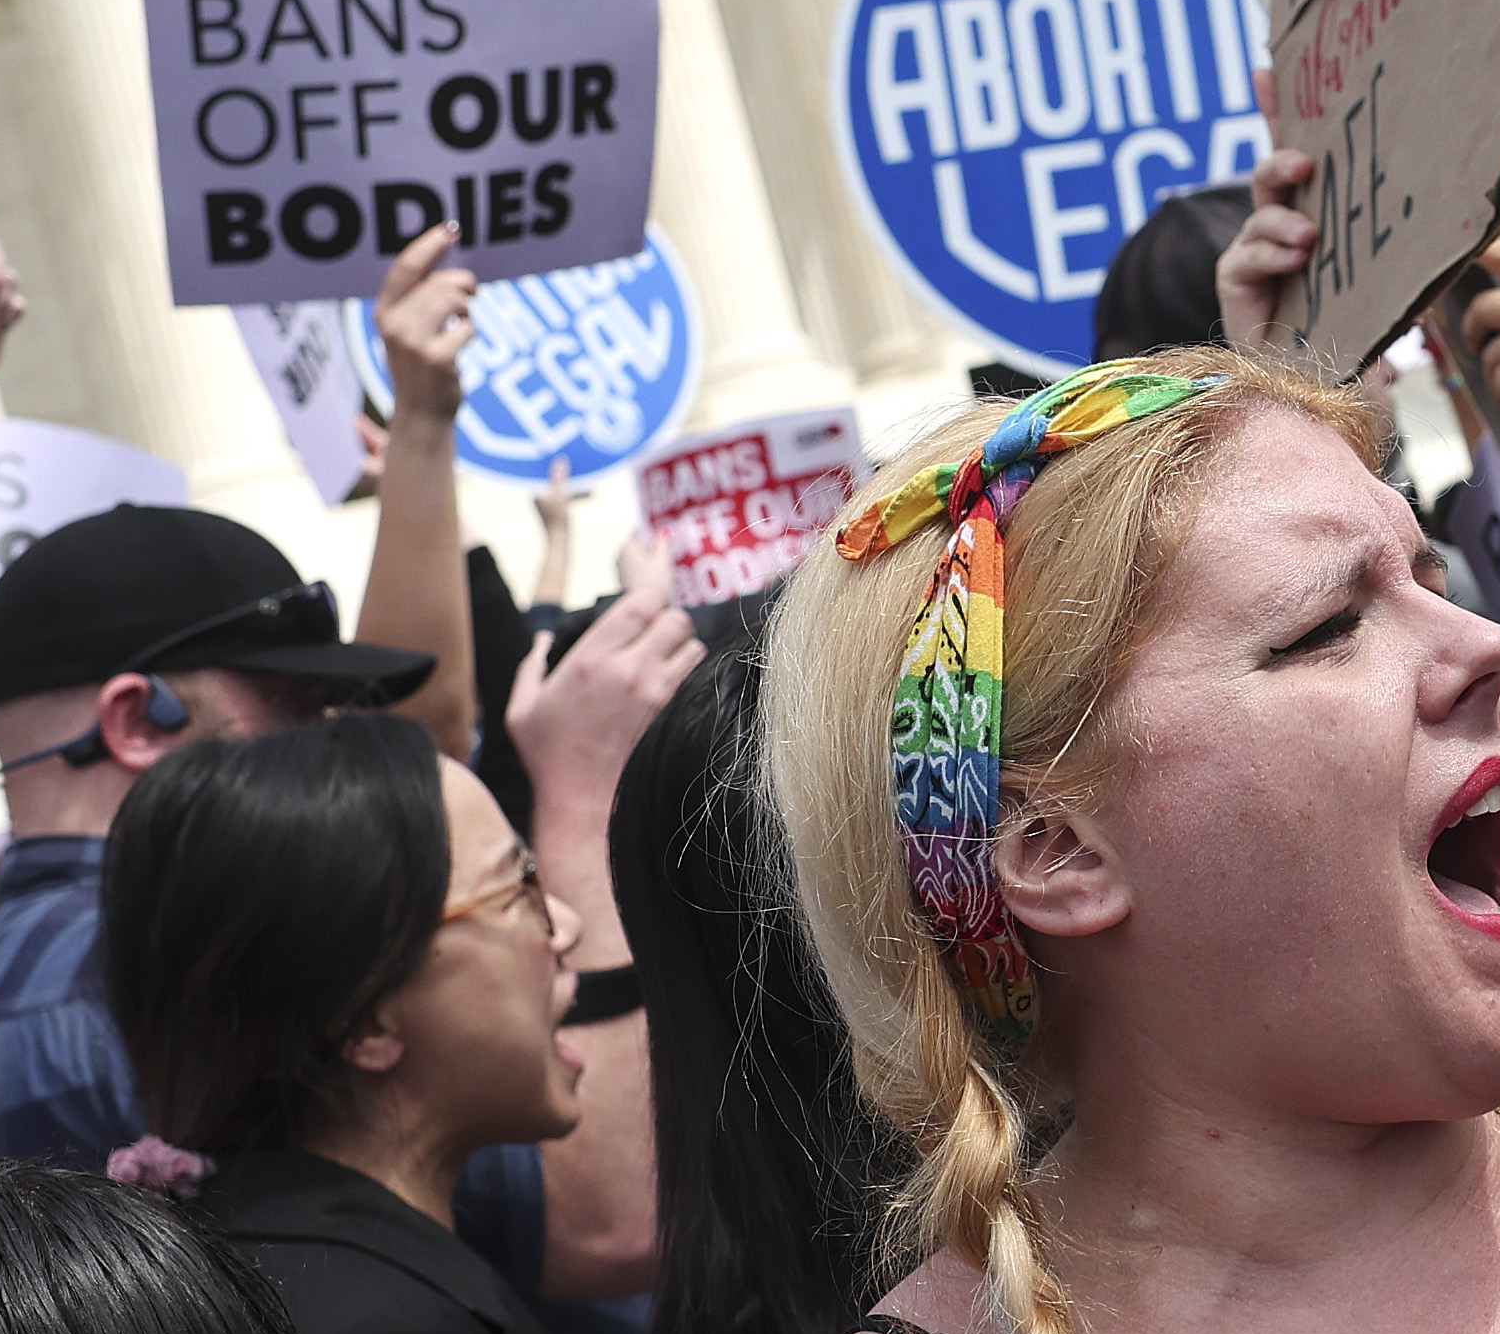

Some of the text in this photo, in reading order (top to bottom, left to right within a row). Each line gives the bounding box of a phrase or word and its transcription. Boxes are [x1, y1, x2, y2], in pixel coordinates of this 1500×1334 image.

[196, 61, 618, 168] OFF OUR
[204, 162, 573, 267] BODIES
